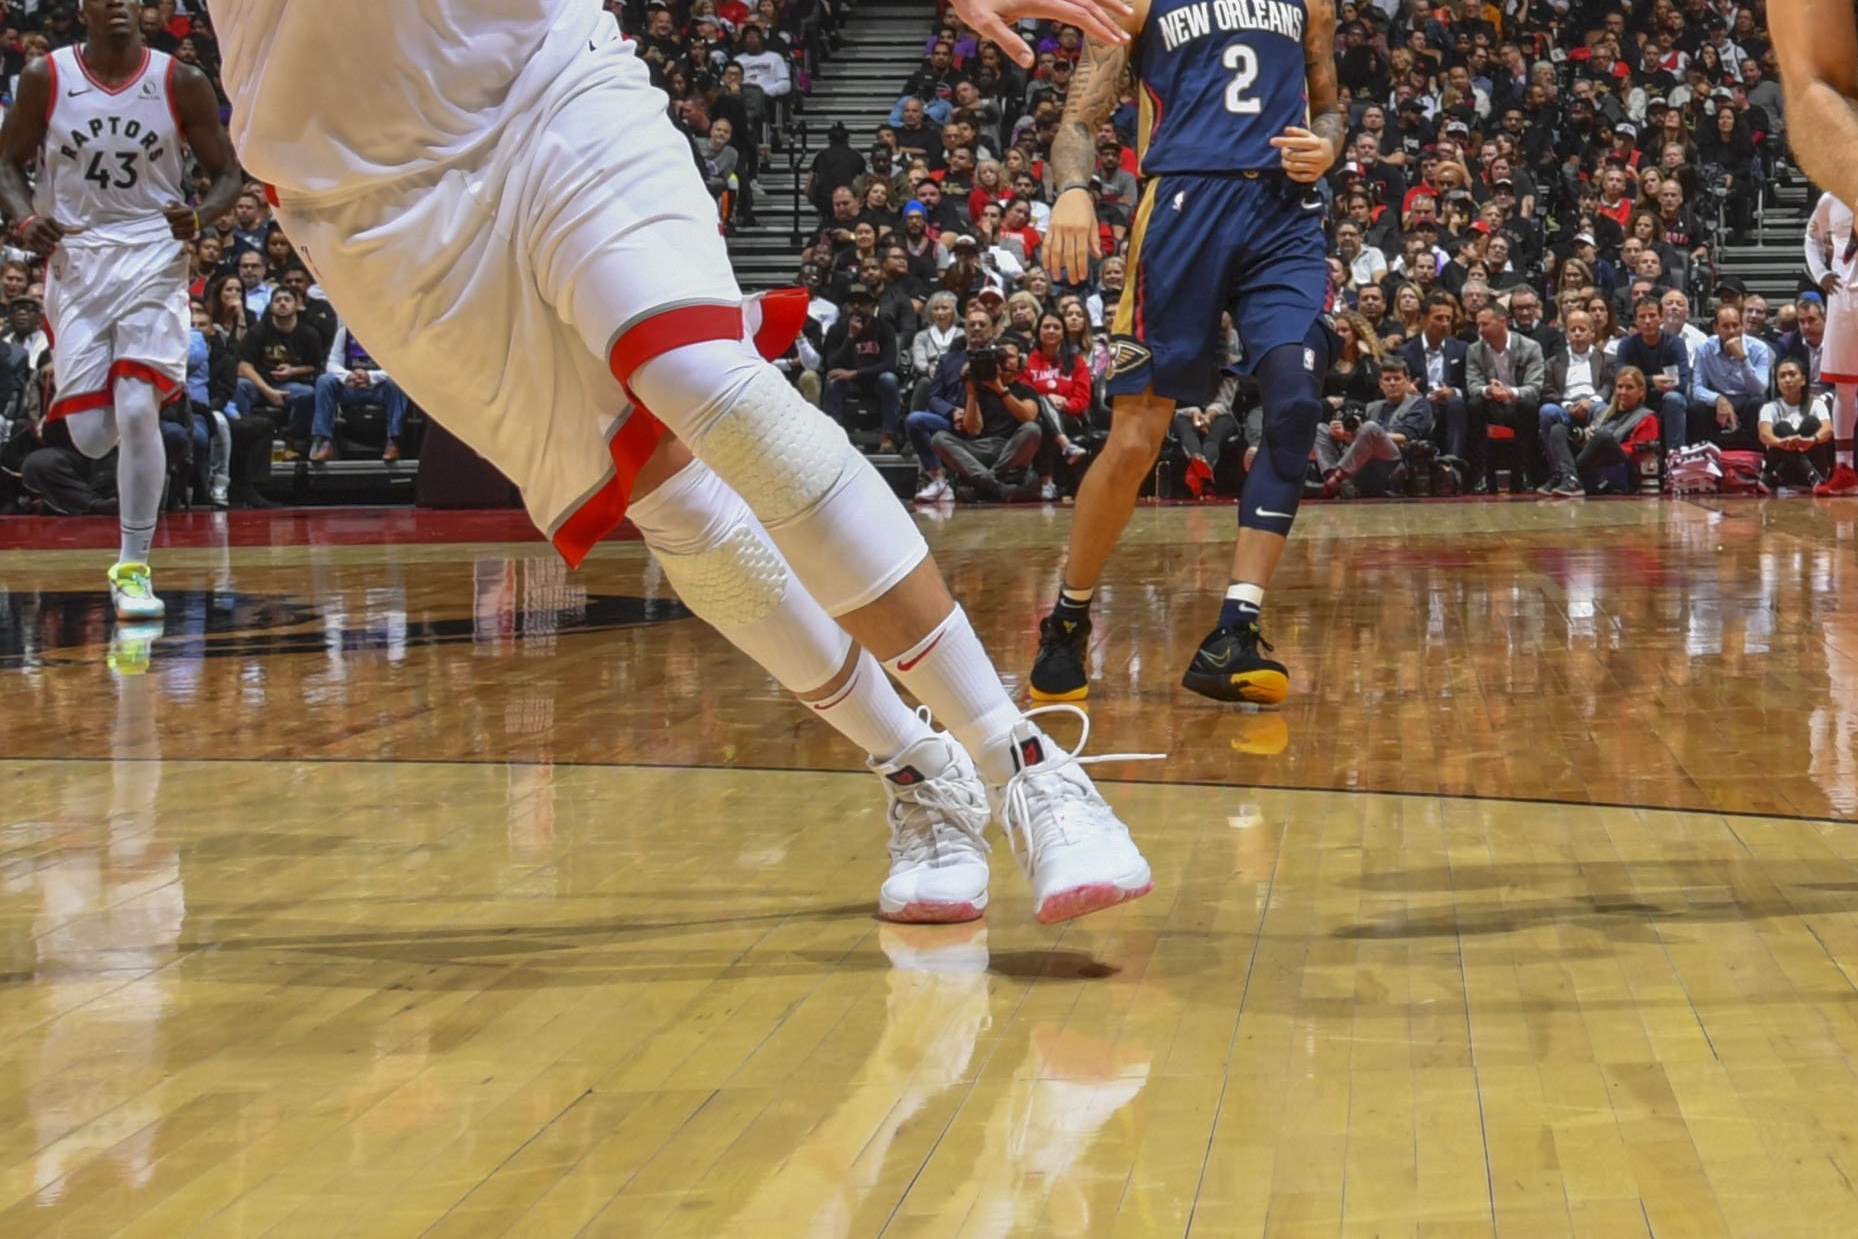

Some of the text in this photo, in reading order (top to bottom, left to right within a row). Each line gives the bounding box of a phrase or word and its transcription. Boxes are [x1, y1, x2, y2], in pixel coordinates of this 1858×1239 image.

[1158, 2, 1211, 52] NEW
[1223, 44, 1261, 113] 2
[61, 116, 164, 162] RAPTORS
[85, 151, 138, 189] 43
